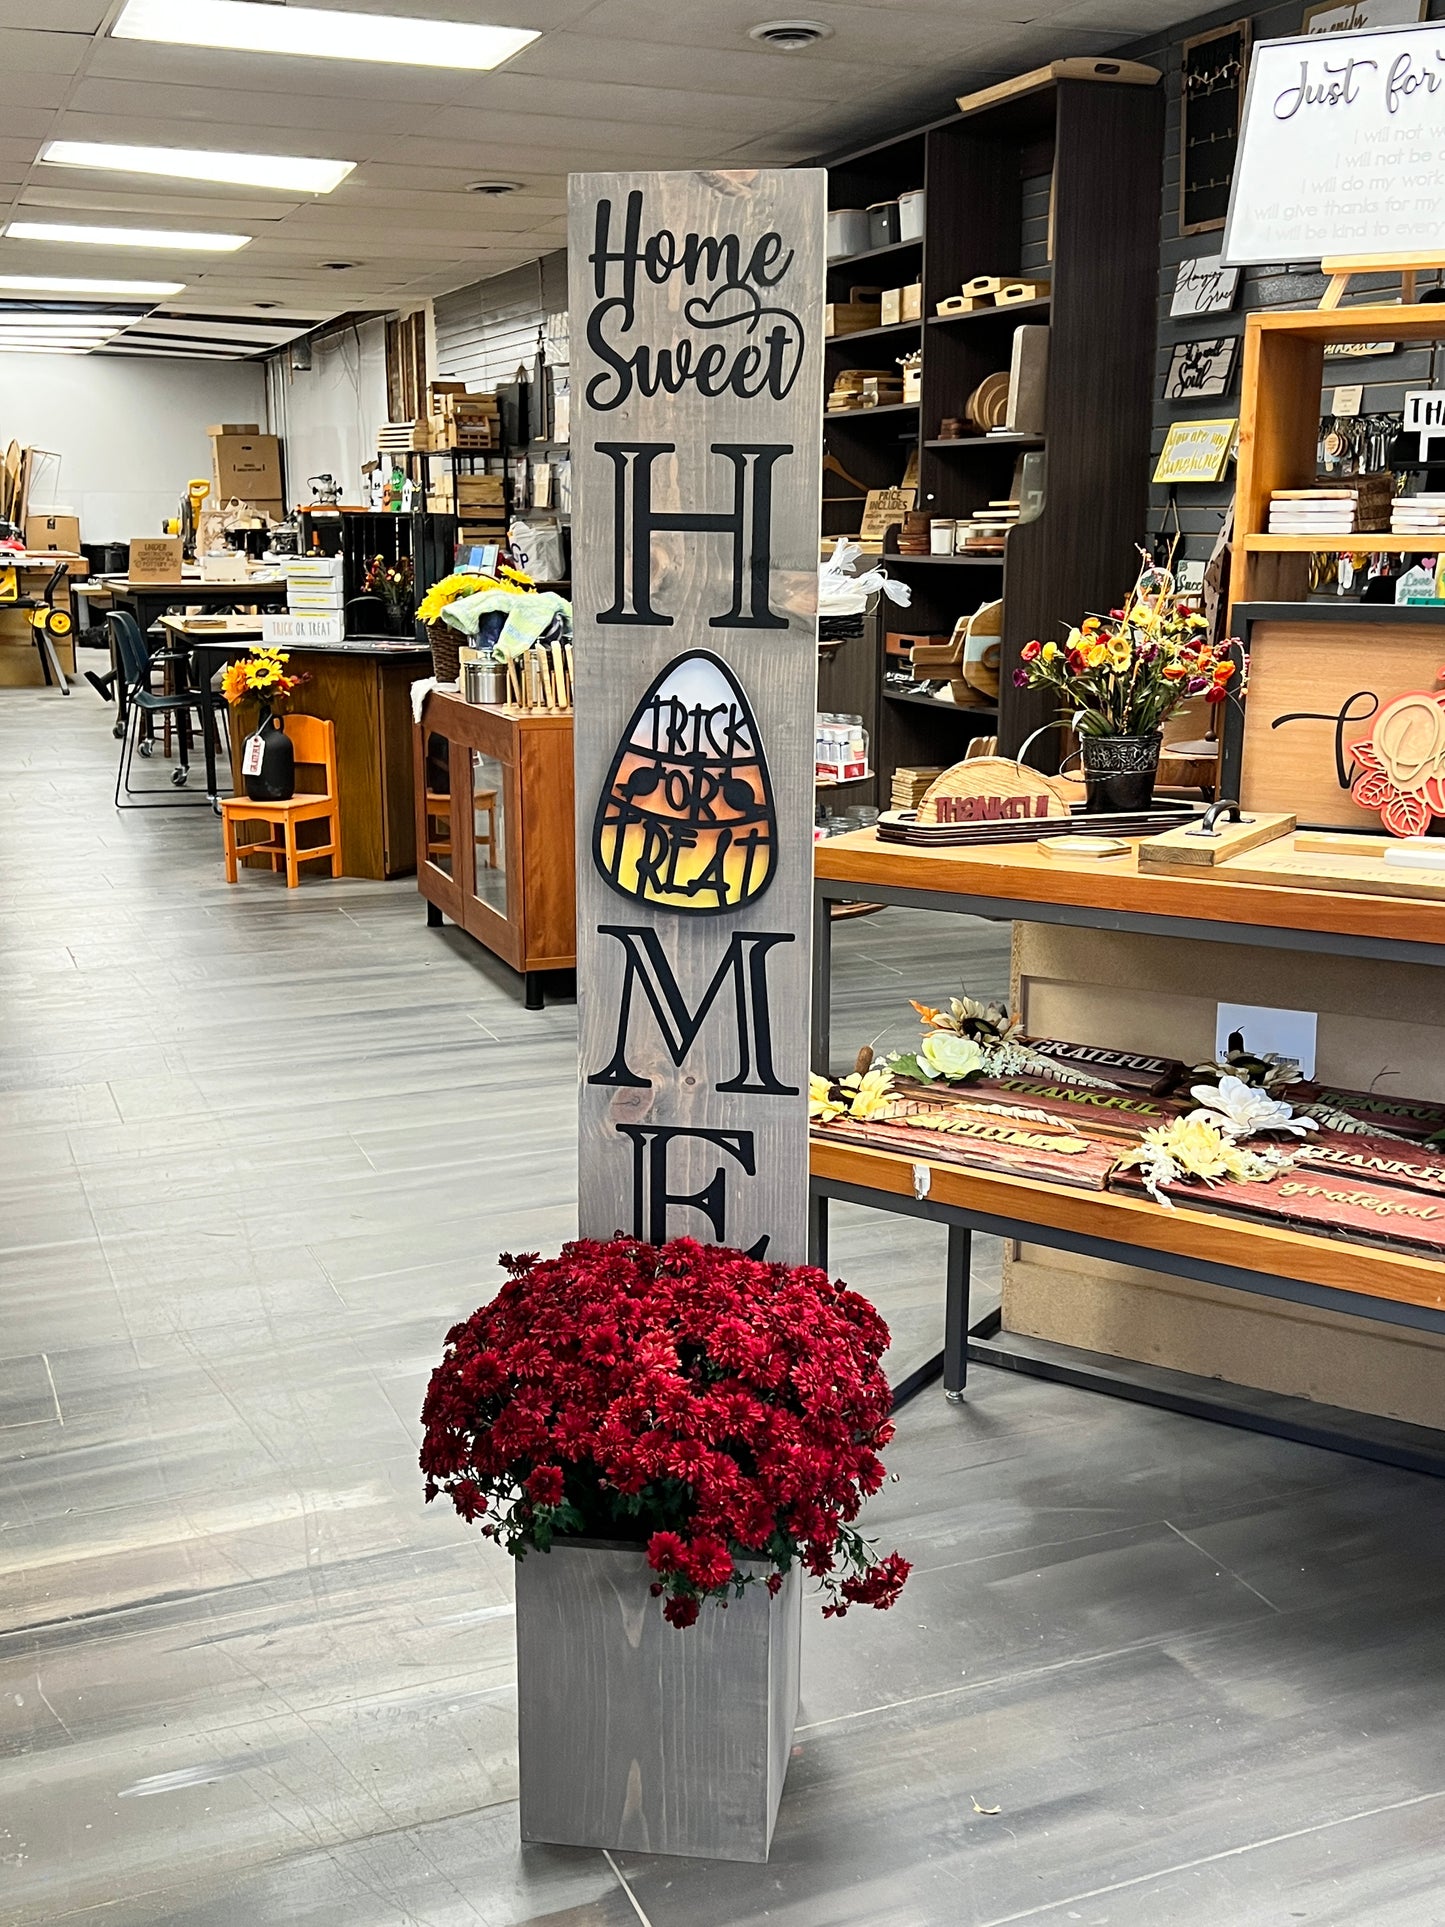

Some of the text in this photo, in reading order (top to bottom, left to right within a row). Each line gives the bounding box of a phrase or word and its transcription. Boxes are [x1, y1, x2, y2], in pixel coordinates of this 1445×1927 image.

[1273, 52, 1443, 120] Just for
[1364, 126, 1391, 144] will
[1394, 123, 1424, 142] not
[1345, 151, 1371, 168] will
[1375, 148, 1406, 167] not
[1408, 147, 1432, 164] be
[1311, 175, 1337, 193] will
[1341, 174, 1364, 192] do
[1369, 177, 1396, 192] my
[1254, 203, 1280, 220] will
[1283, 203, 1318, 221] give
[1325, 196, 1379, 216] thanks
[1385, 196, 1410, 213] for
[588, 190, 794, 300] Home
[1305, 224, 1326, 240] be
[1332, 221, 1368, 240] kind
[1374, 221, 1390, 237] to
[586, 292, 805, 411] Sweet
[1172, 359, 1213, 399] Soul
[1191, 428, 1208, 444] are
[1210, 432, 1227, 452] my
[869, 501, 908, 510] INCLUDES
[879, 491, 902, 501] PRICE
[1403, 572, 1431, 587] Love
[272, 621, 330, 636] TRICK OR TREAT
[645, 694, 752, 759] TRICK
[665, 763, 719, 822] OR
[604, 807, 771, 905] TREAT
[1029, 1039, 1167, 1074] GRATEFUL
[1001, 1079, 1163, 1117] THANKFUL
[932, 1117, 1055, 1151] WELCOME
[1278, 1181, 1445, 1221] grateful
